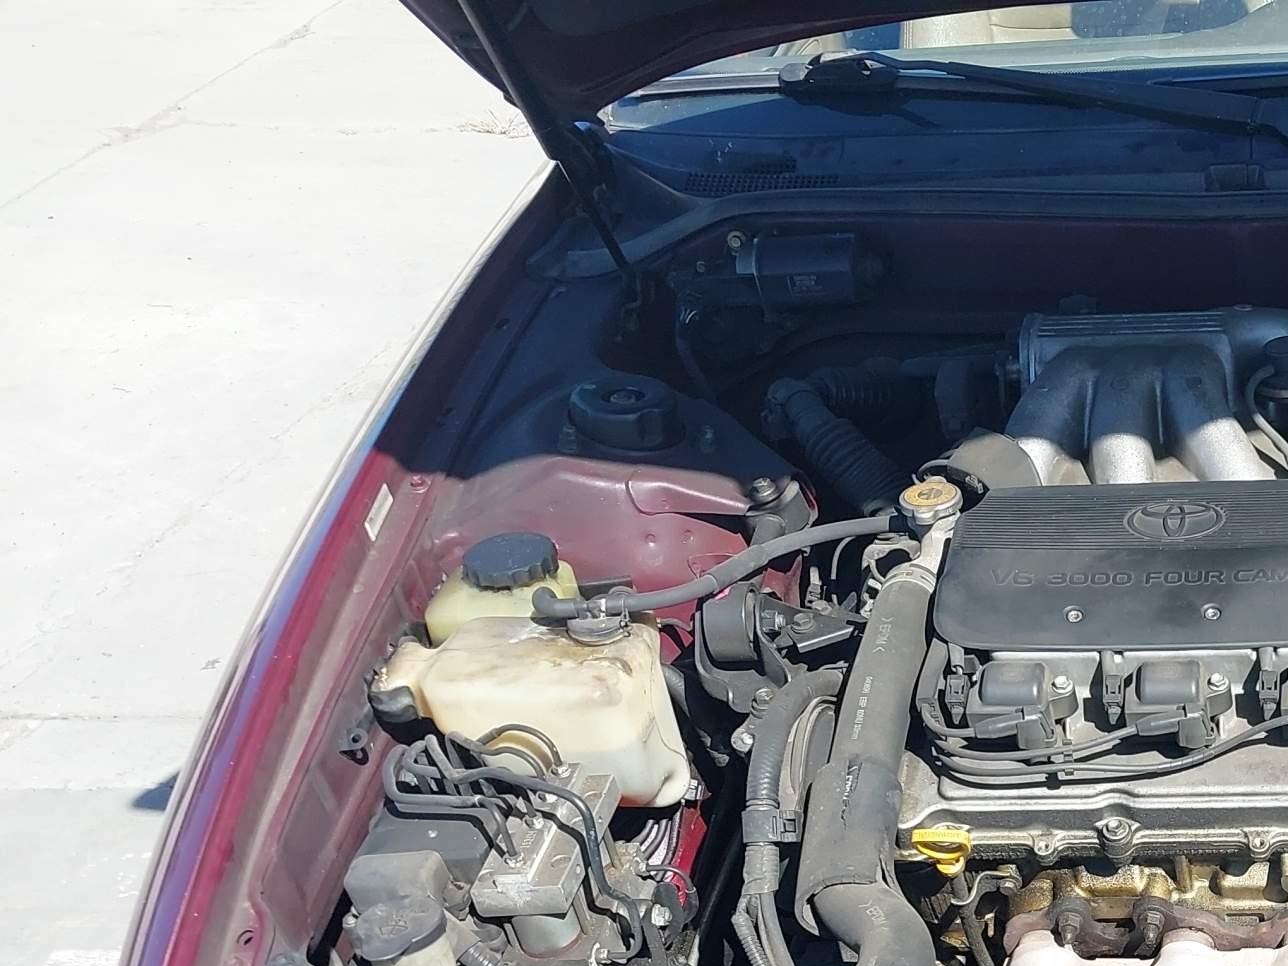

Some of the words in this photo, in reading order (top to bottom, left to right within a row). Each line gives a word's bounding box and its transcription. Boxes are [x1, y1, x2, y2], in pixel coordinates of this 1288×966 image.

[991, 569, 1033, 586] V6
[1047, 570, 1132, 586] 3000
[1144, 570, 1226, 585] FOUR
